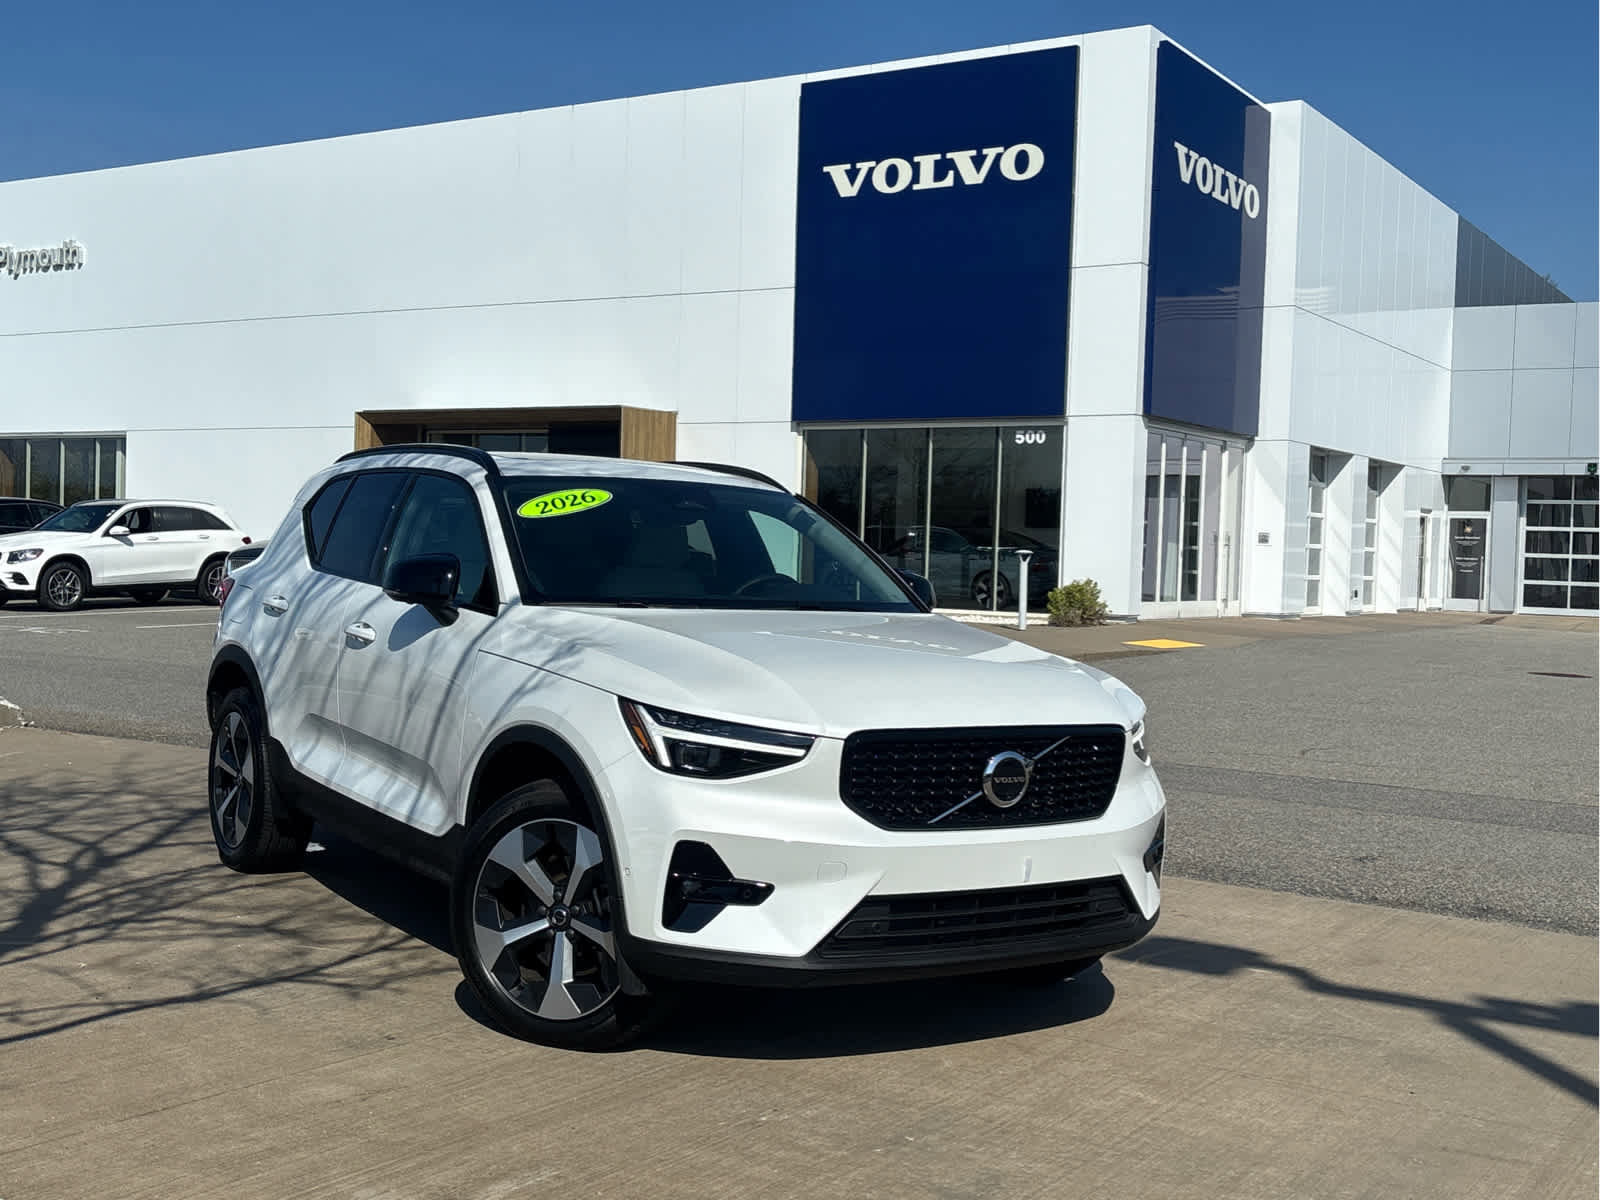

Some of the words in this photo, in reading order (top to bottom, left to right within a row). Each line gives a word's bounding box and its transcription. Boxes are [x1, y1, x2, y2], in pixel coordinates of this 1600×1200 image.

[823, 143, 1045, 198] VOLVO
[1173, 140, 1260, 219] VOLVO
[1015, 430, 1046, 444] 500
[535, 491, 596, 514] 2026
